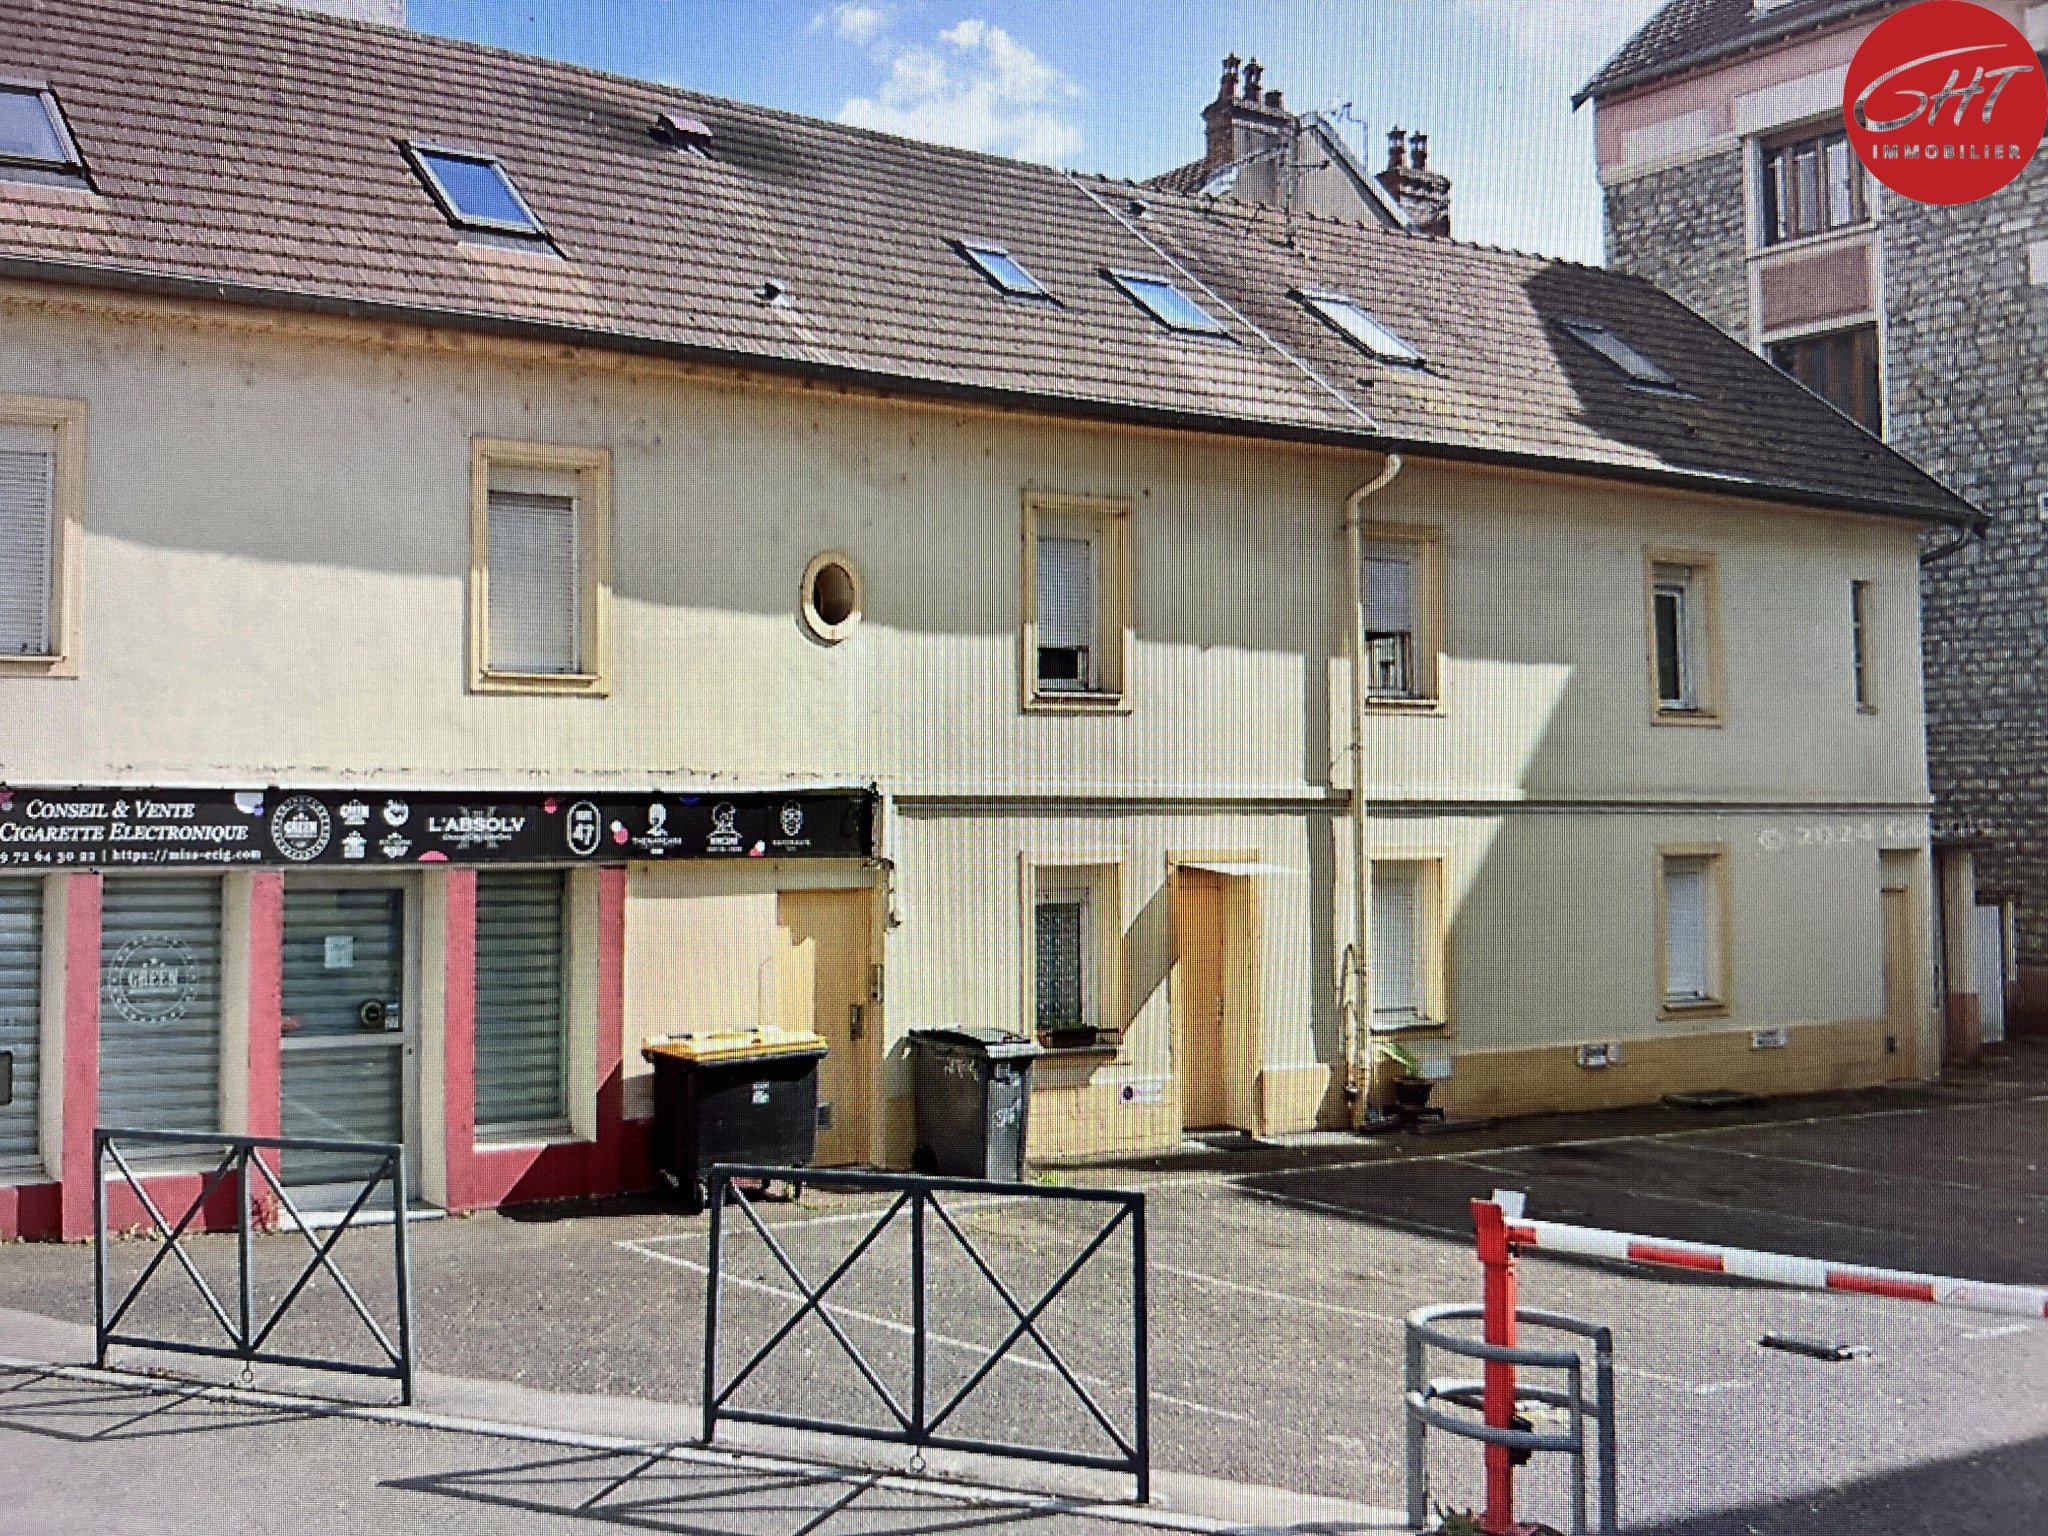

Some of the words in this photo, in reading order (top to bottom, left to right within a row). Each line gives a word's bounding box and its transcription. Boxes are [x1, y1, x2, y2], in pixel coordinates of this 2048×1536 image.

[26, 799, 108, 819] CONSEIL
[112, 799, 130, 818] &
[135, 801, 195, 818] VENTE
[0, 823, 104, 842] CIGARETTE
[108, 823, 248, 844] ELECTRONIQUE
